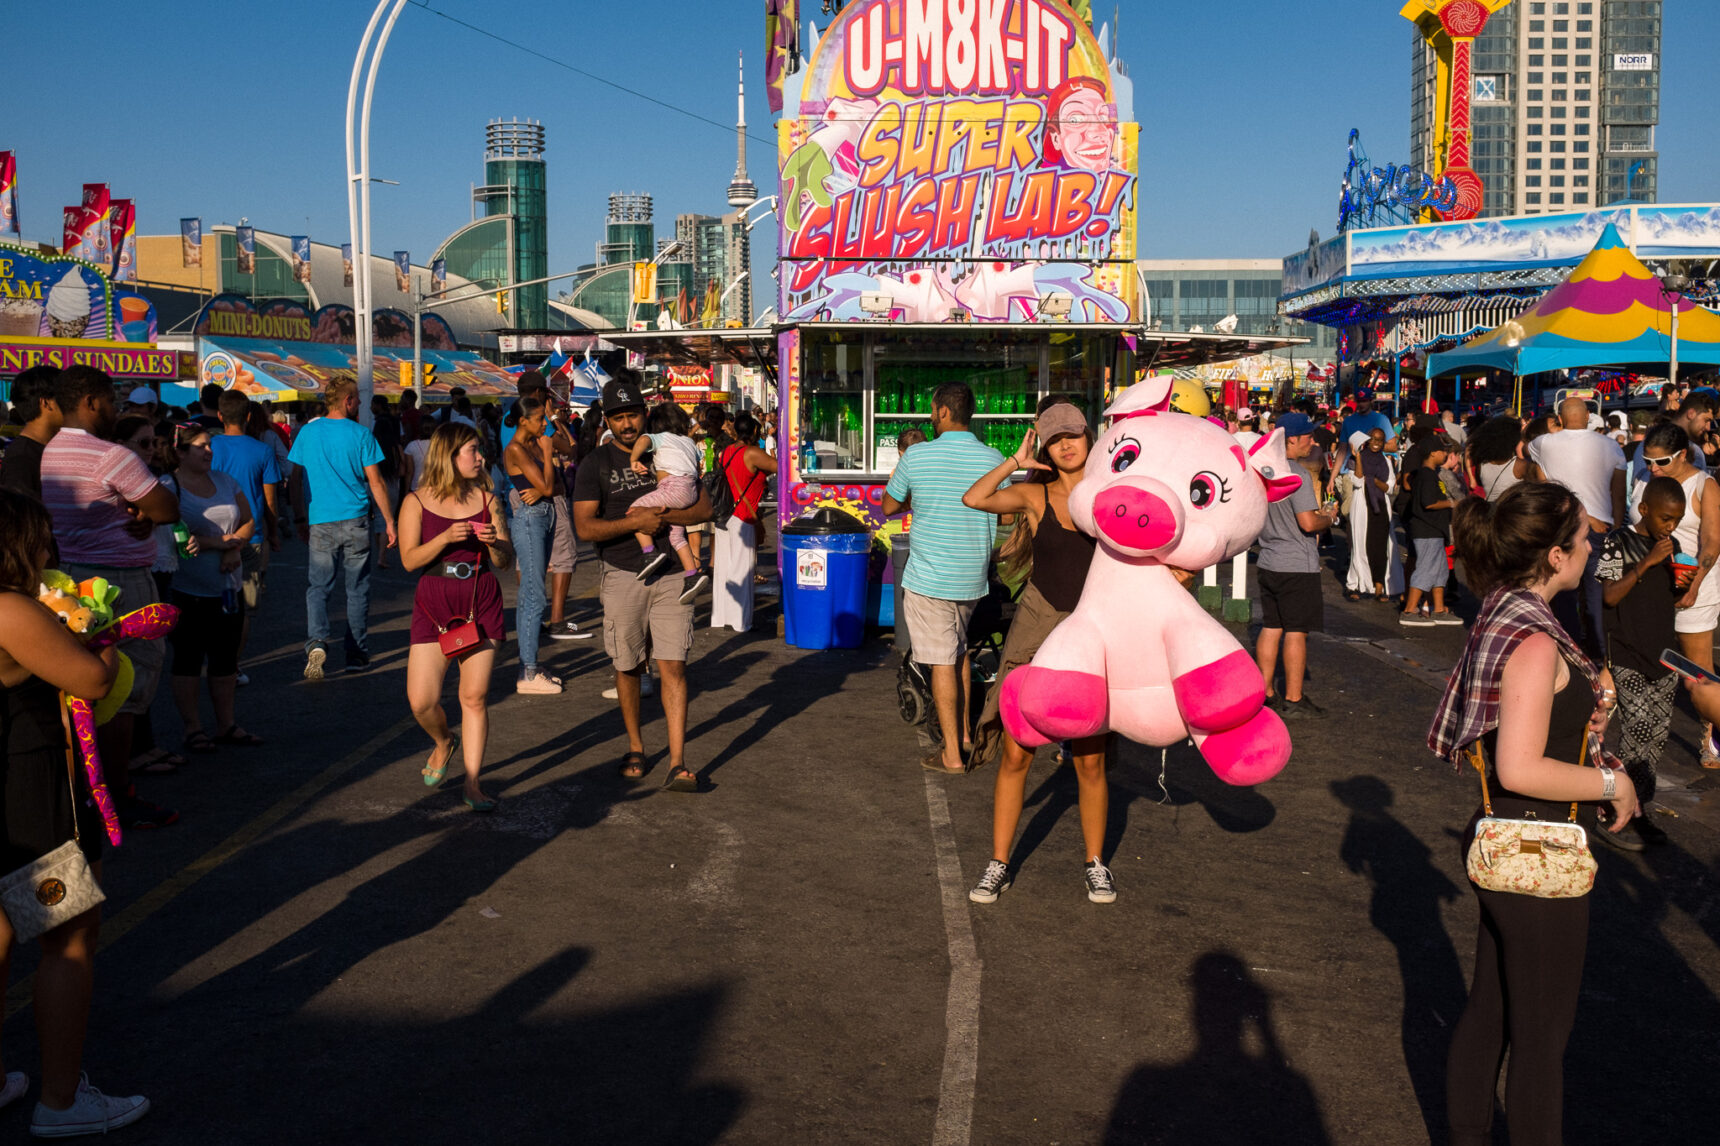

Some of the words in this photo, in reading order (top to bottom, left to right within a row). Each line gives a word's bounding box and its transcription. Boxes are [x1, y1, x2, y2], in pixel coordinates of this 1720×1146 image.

[858, 99, 1044, 188] SUPER
[791, 174, 980, 291] SLUSH
[983, 170, 1133, 245] LAB!
[209, 310, 312, 340] MINI-DONUTS
[73, 351, 173, 375] SUNDAES
